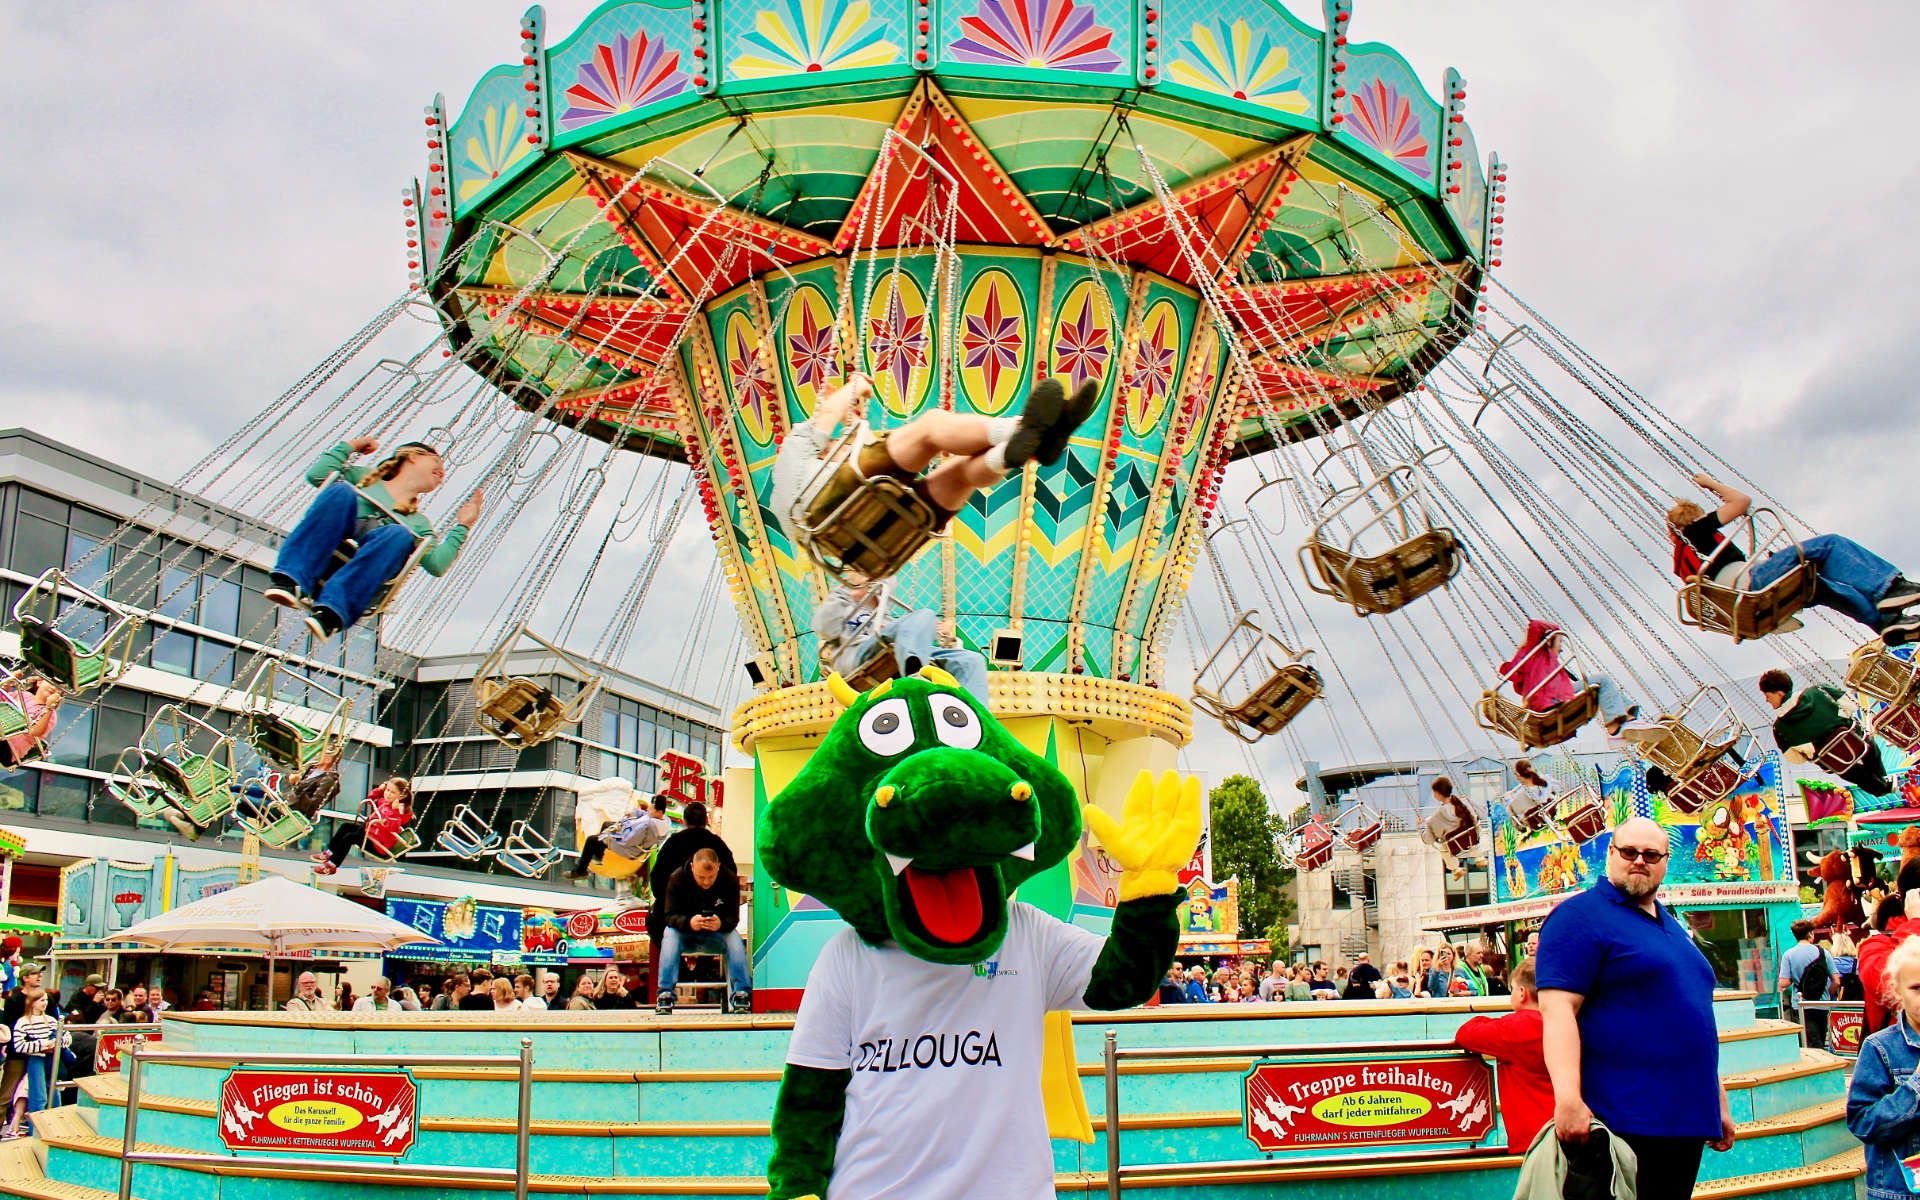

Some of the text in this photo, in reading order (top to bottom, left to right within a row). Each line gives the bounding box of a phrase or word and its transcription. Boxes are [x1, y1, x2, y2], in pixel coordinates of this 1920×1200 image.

[855, 1030, 1003, 1072] DELLOUGA
[1288, 1066, 1453, 1102] Treppe freihalten
[252, 1078, 383, 1110] Fliegen ist schön
[1342, 1094, 1402, 1106] Ab 6 Jahren
[294, 1106, 337, 1116] Das Karussell
[1322, 1106, 1422, 1120] darf jeder mitfahren
[284, 1116, 292, 1125] für
[293, 1117, 303, 1125] die
[323, 1117, 345, 1126] Familie
[1349, 1128, 1406, 1140] KETTENFLIEGER
[1408, 1126, 1451, 1138] WUPPERTAL
[293, 1137, 338, 1147] KETTENFLIEGER
[340, 1138, 376, 1149] WUPPERTAL
